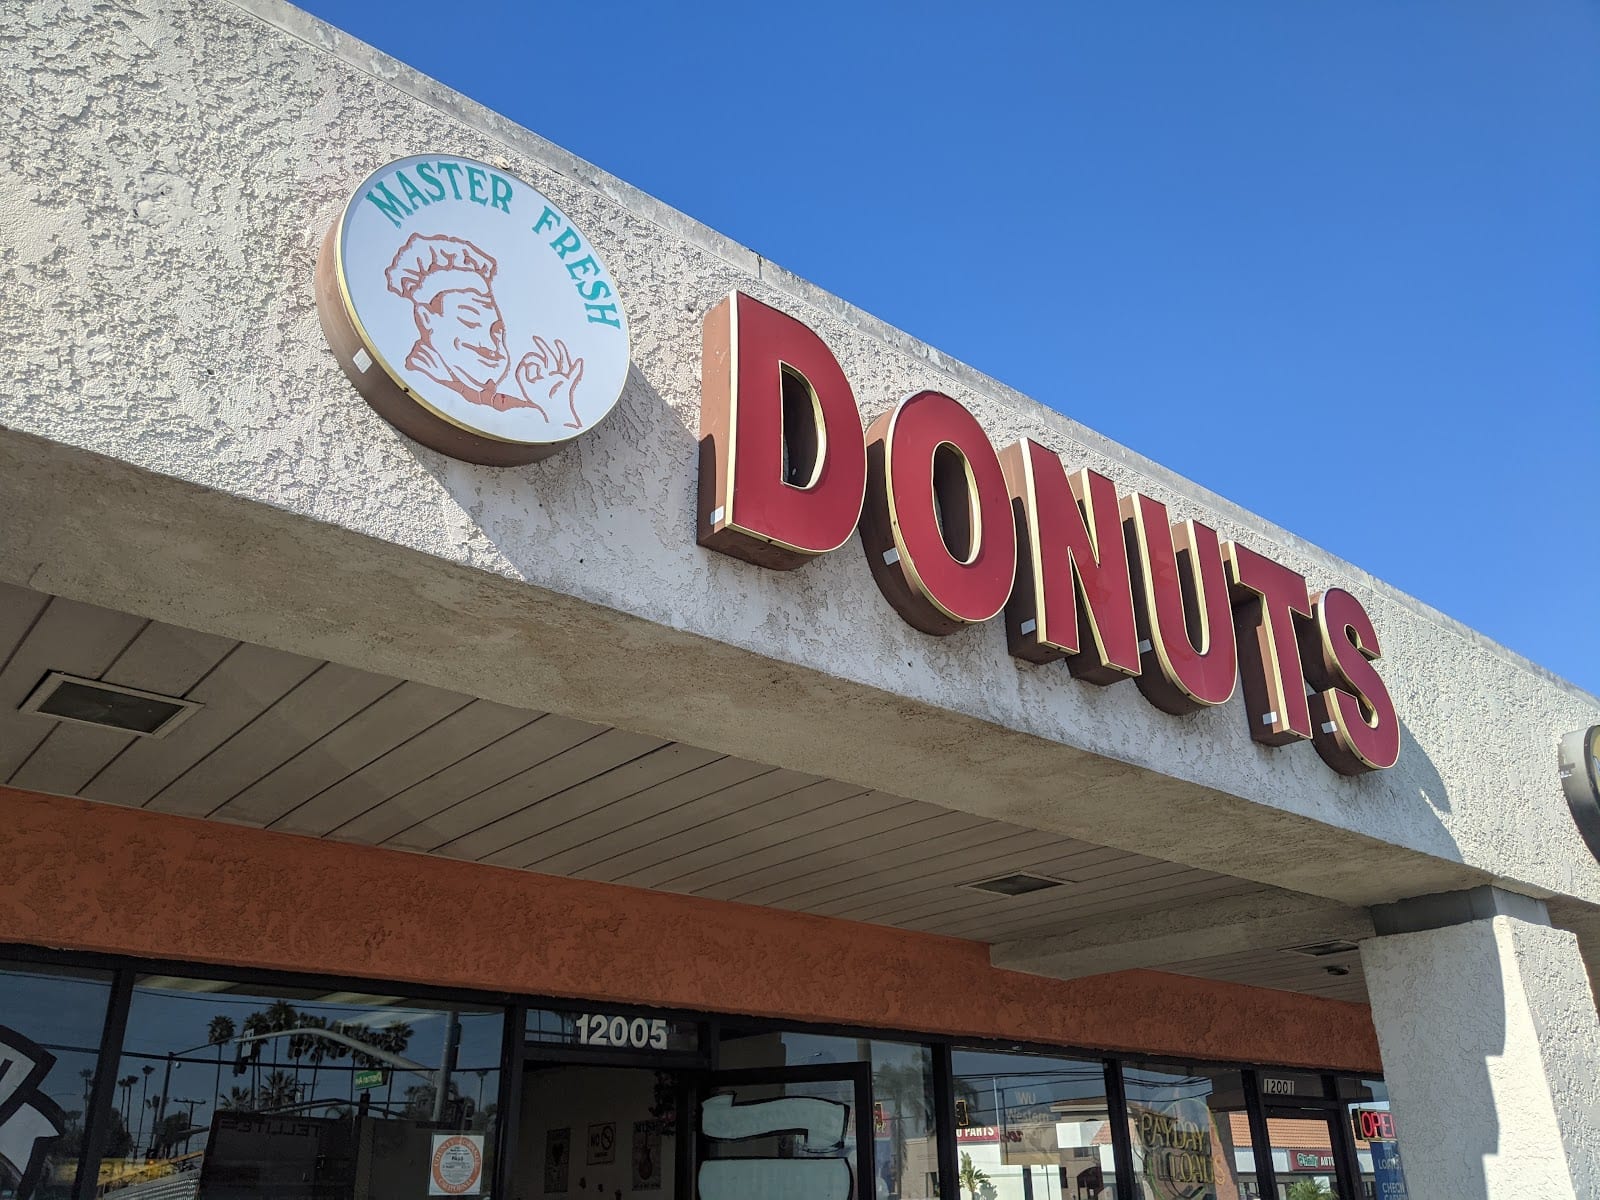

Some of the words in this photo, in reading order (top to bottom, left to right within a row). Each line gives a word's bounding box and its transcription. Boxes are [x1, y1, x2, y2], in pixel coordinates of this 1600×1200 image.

[366, 160, 513, 229] MASTER
[531, 204, 621, 330] FRESH
[715, 288, 1401, 770] DONUTS
[575, 1013, 668, 1050] 12005
[1265, 1079, 1295, 1095] 12001
[1141, 1112, 1205, 1152] PAYDAY
[1169, 1151, 1226, 1185] LOANS
